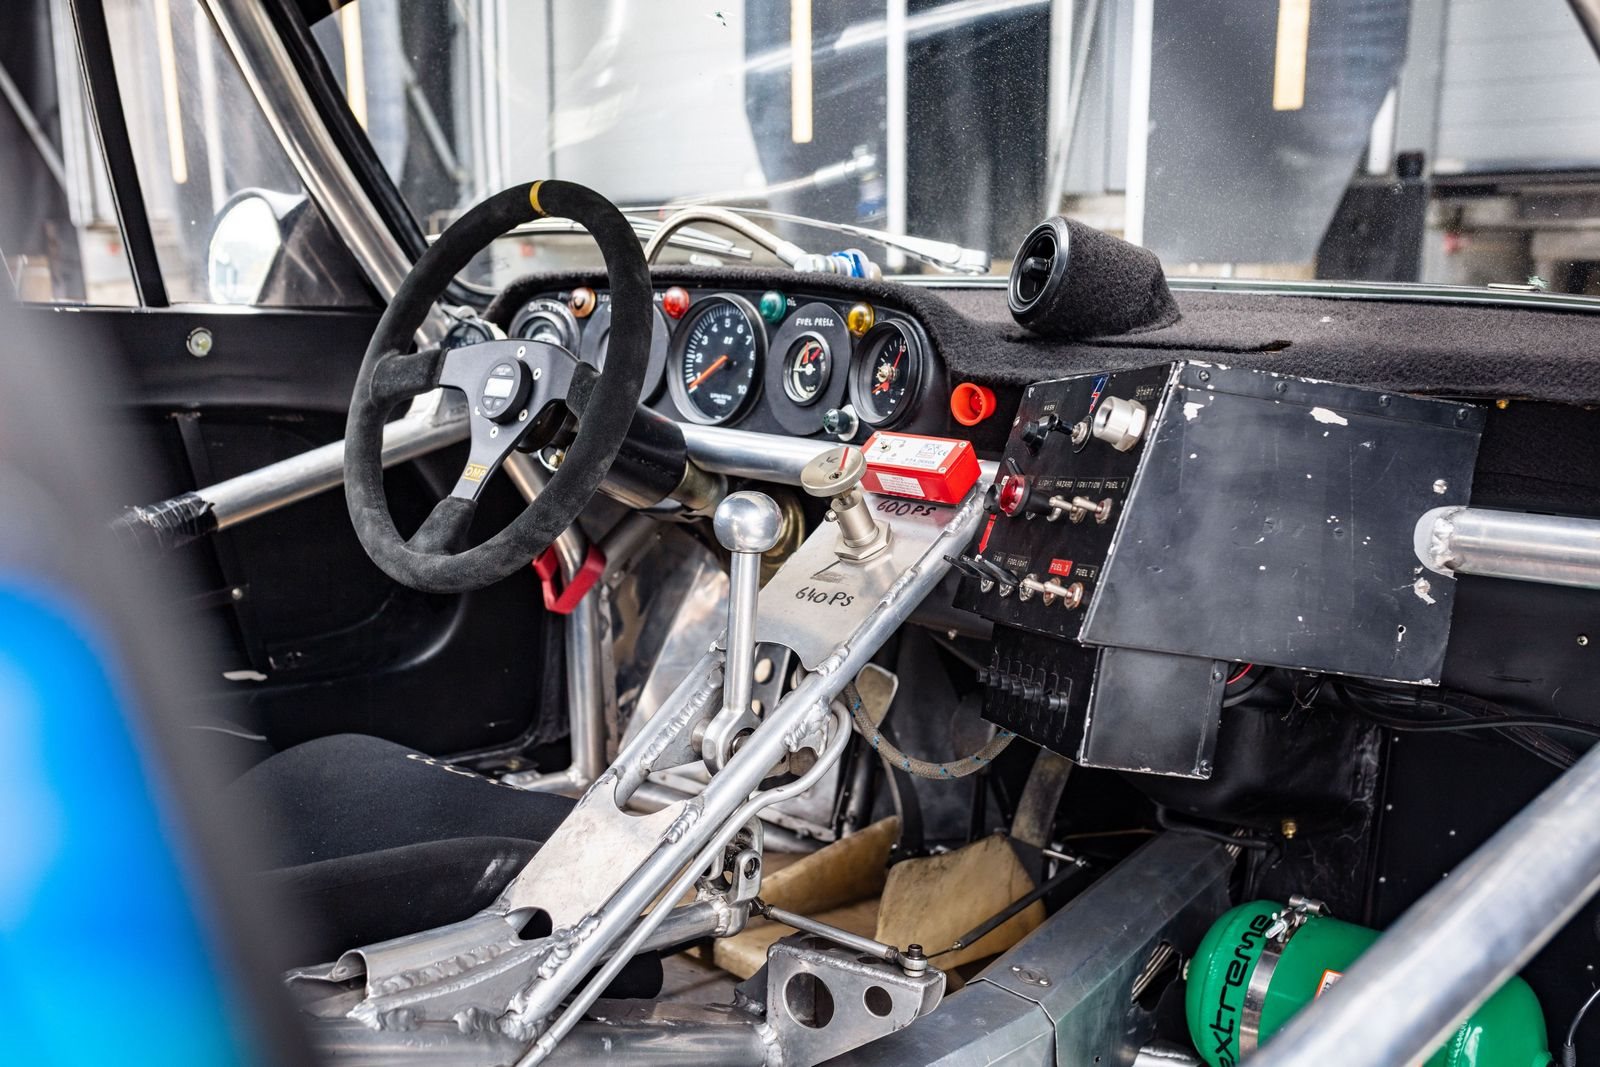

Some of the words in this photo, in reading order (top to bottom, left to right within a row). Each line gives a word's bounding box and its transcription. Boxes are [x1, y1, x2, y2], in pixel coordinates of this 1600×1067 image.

[724, 318, 731, 328] 5
[796, 318, 812, 326] FUEL
[712, 324, 718, 332] 4
[736, 324, 744, 334] 6
[702, 336, 708, 345] 3
[746, 335, 752, 346] 7
[695, 352, 703, 363] 2
[737, 384, 747, 394] 10
[465, 466, 486, 480] OMP
[876, 500, 910, 516] 600
[910, 504, 937, 516] PS
[1050, 562, 1064, 570] FUEL
[1075, 568, 1088, 576] FUEL
[795, 586, 828, 604] 640
[828, 592, 854, 607] PS
